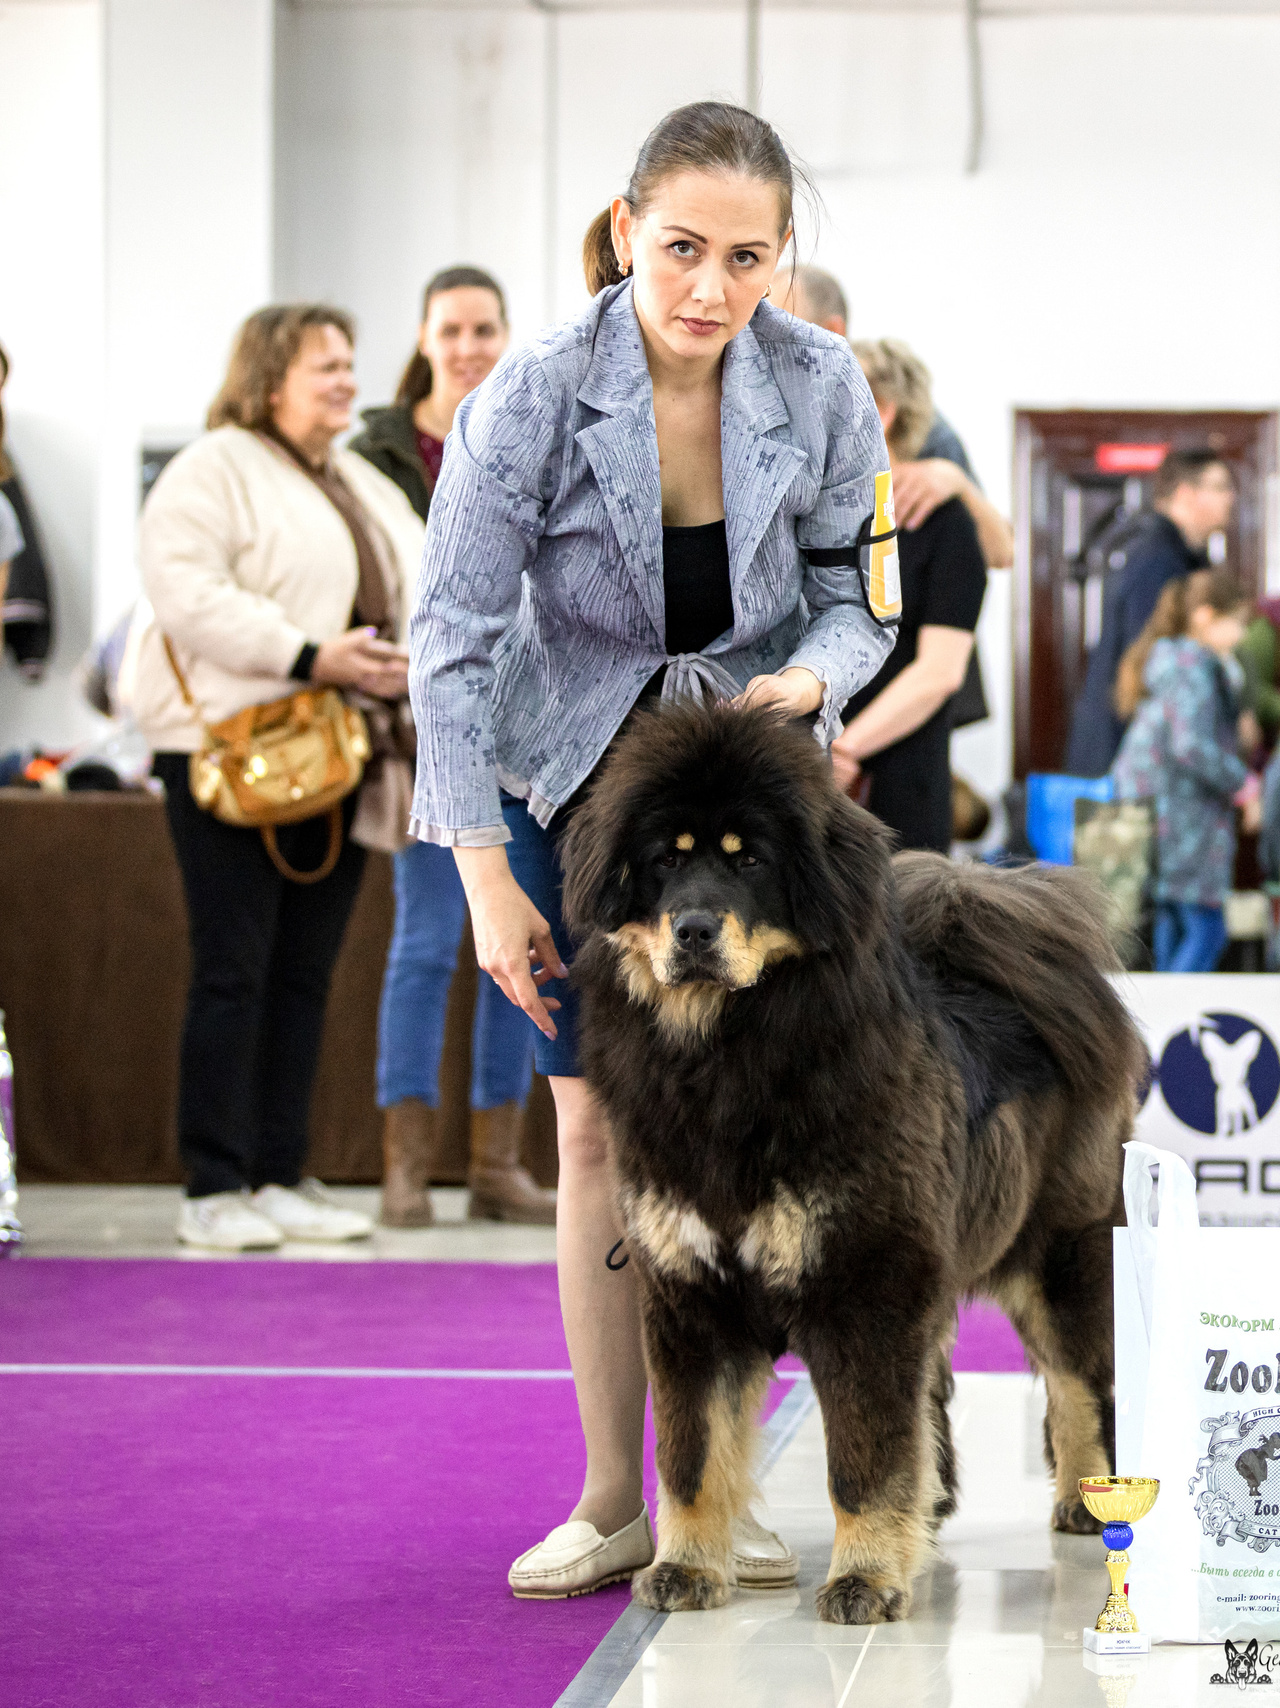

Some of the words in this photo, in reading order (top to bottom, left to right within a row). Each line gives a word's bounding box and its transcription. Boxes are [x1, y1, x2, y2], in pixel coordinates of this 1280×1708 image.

[1252, 1408, 1274, 1418] HIGH
[1258, 1527, 1280, 1537] CAT
[1232, 1566, 1265, 1578] всегда
[1268, 1568, 1274, 1578] в
[1216, 1593, 1247, 1603] e-mail:
